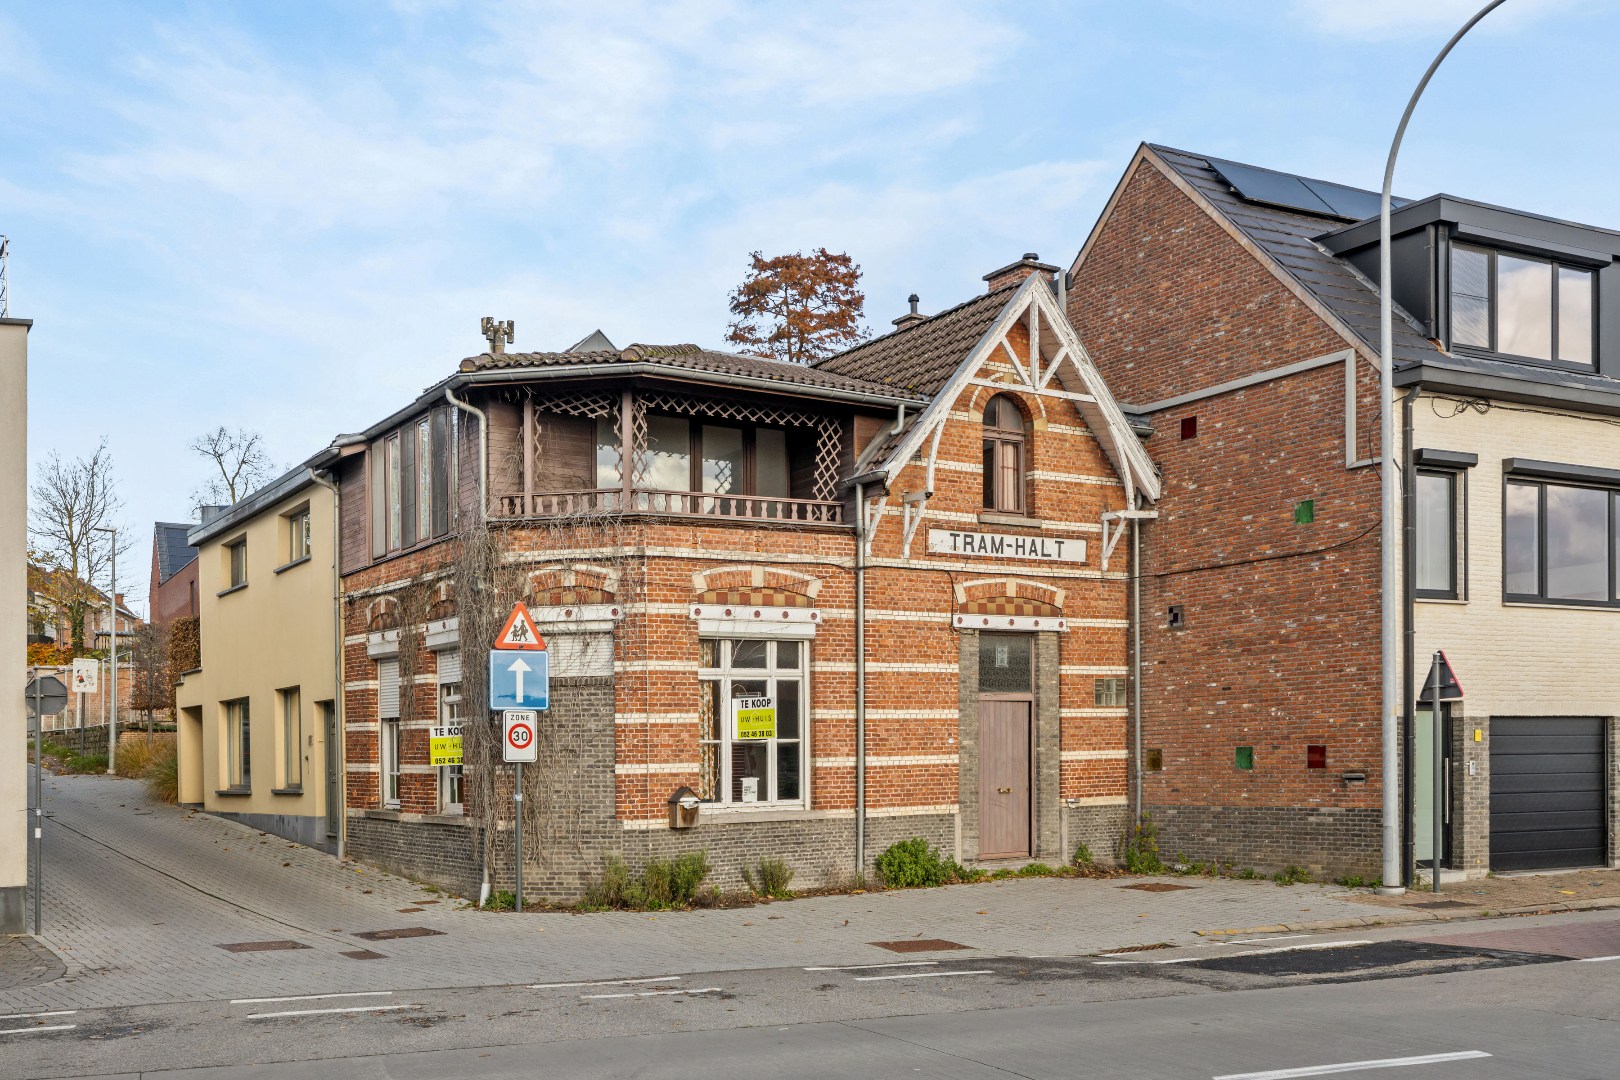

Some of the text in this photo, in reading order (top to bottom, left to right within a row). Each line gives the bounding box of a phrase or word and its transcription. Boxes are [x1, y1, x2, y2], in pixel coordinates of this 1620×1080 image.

[949, 532, 1065, 559] TRAM-HALT
[740, 698, 772, 709] TE KOOP
[433, 727, 445, 737] TE
[512, 730, 529, 742] 30
[434, 757, 446, 765] 052
